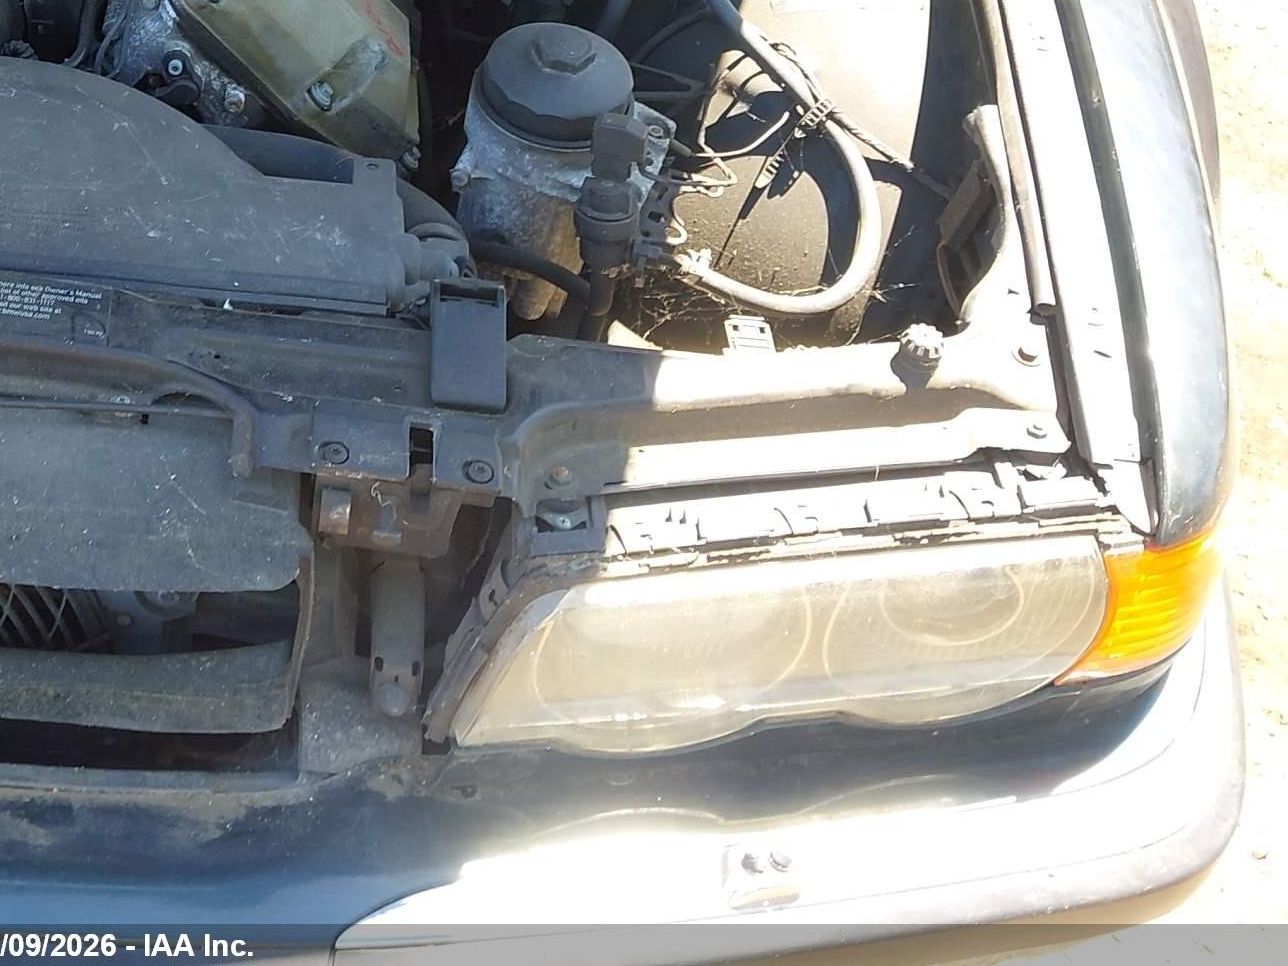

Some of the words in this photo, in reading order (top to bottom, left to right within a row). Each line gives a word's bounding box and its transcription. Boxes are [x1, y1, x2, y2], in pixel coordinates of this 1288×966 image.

[41, 294, 74, 303] approved
[75, 296, 88, 304] oils
[75, 289, 102, 299] Manual
[23, 303, 38, 311] web
